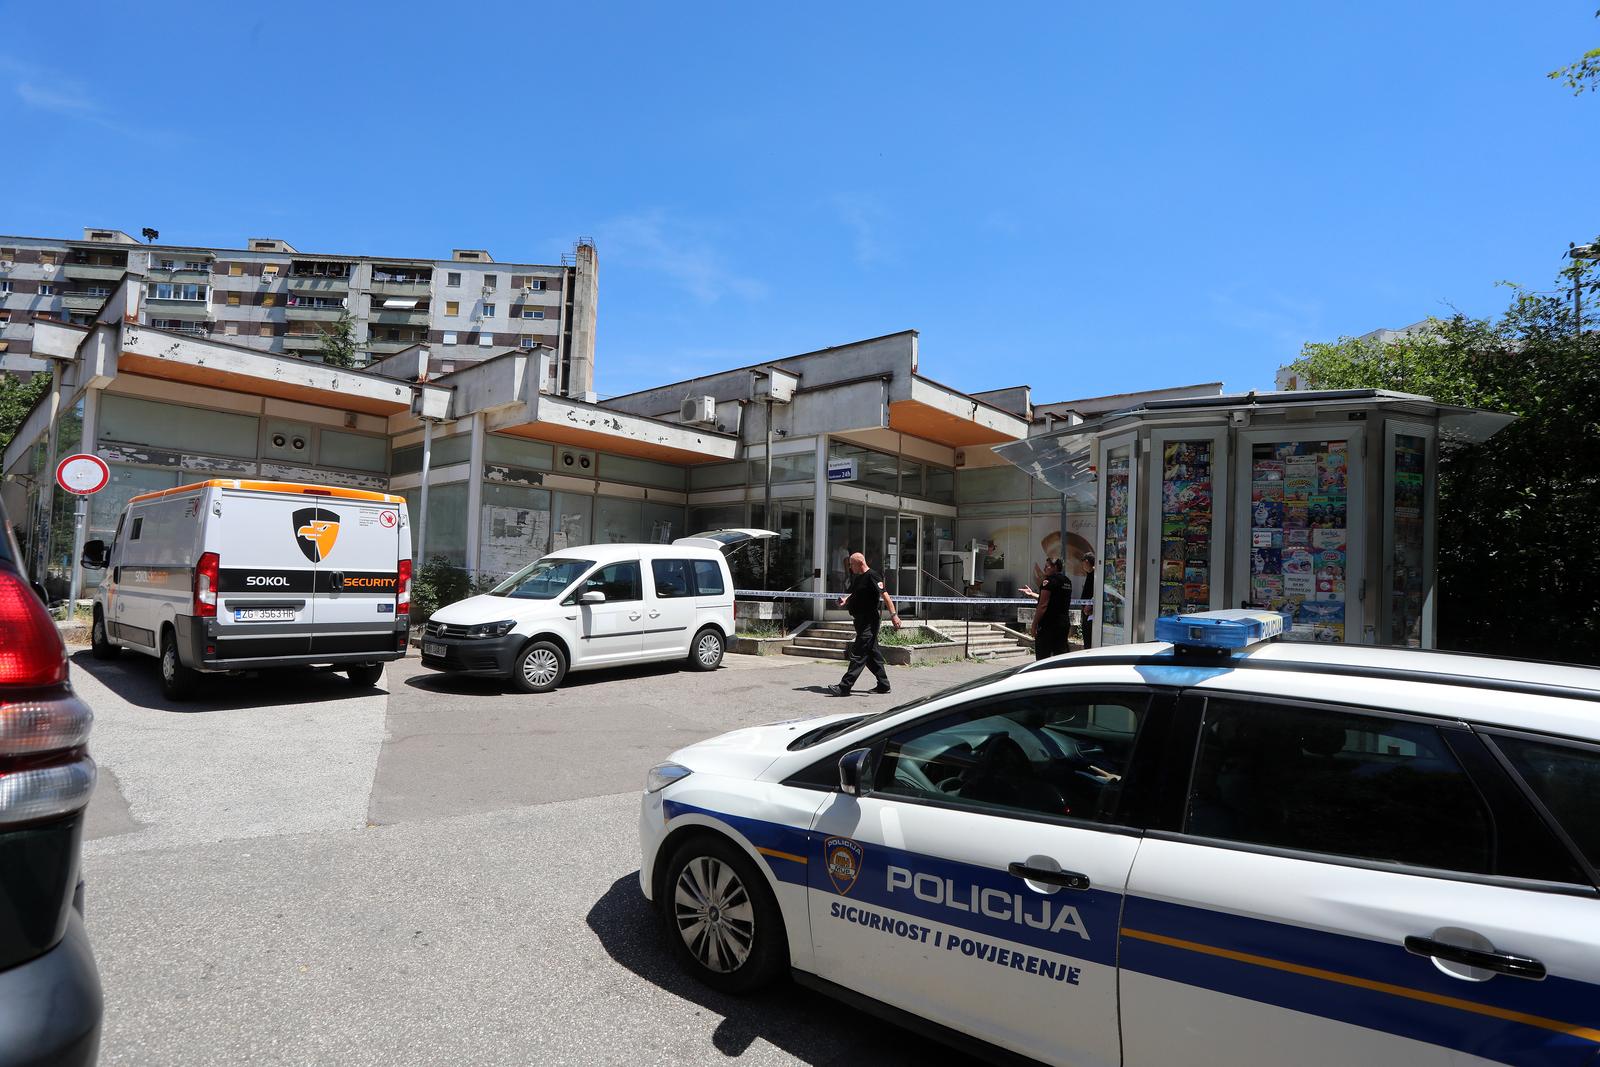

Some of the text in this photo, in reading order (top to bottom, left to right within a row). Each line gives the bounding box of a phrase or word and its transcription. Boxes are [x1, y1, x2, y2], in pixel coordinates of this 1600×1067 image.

[246, 576, 397, 587] SOKOL SECURITY
[242, 609, 254, 619] ZG
[828, 840, 861, 855] POLICIJA
[886, 865, 1091, 941] POLICIJA
[934, 932, 942, 947] I
[947, 935, 1081, 986] POVJERENJE
